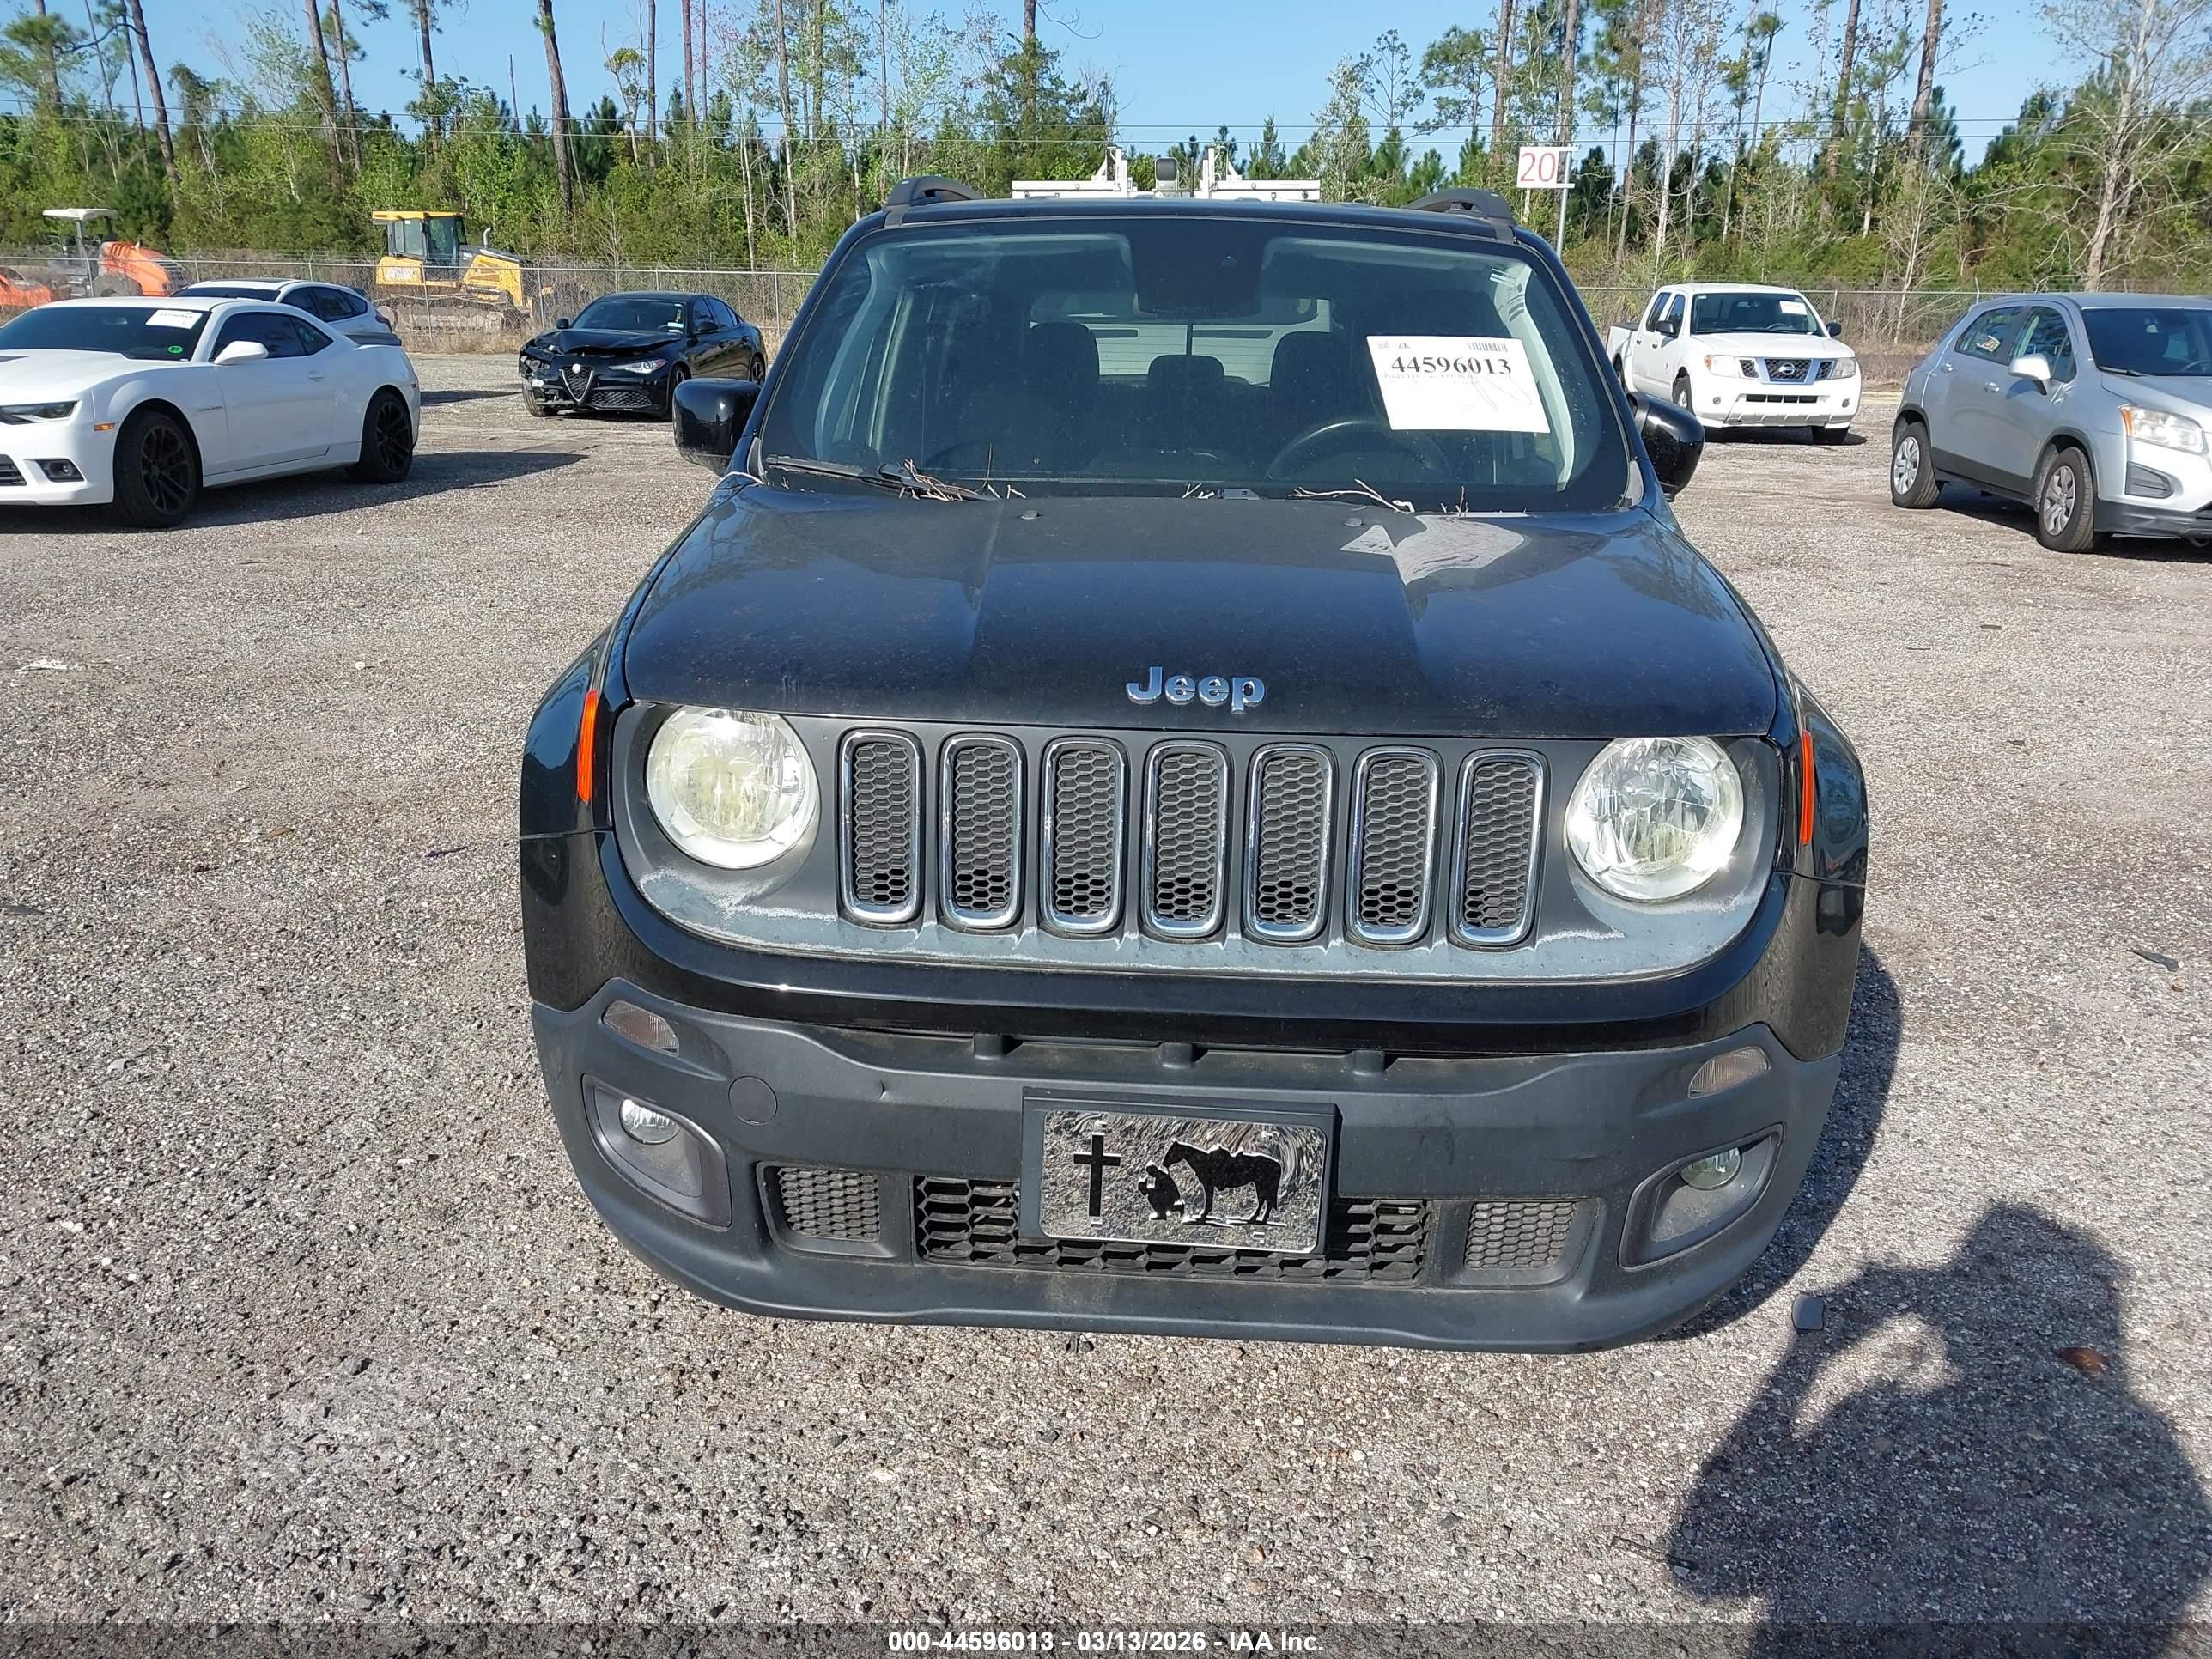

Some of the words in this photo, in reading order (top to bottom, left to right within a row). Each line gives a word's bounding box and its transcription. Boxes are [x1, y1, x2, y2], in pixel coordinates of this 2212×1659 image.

[1520, 152, 1556, 182] 20
[1391, 356, 1511, 375] 44596013
[1126, 666, 1266, 714] Jeep
